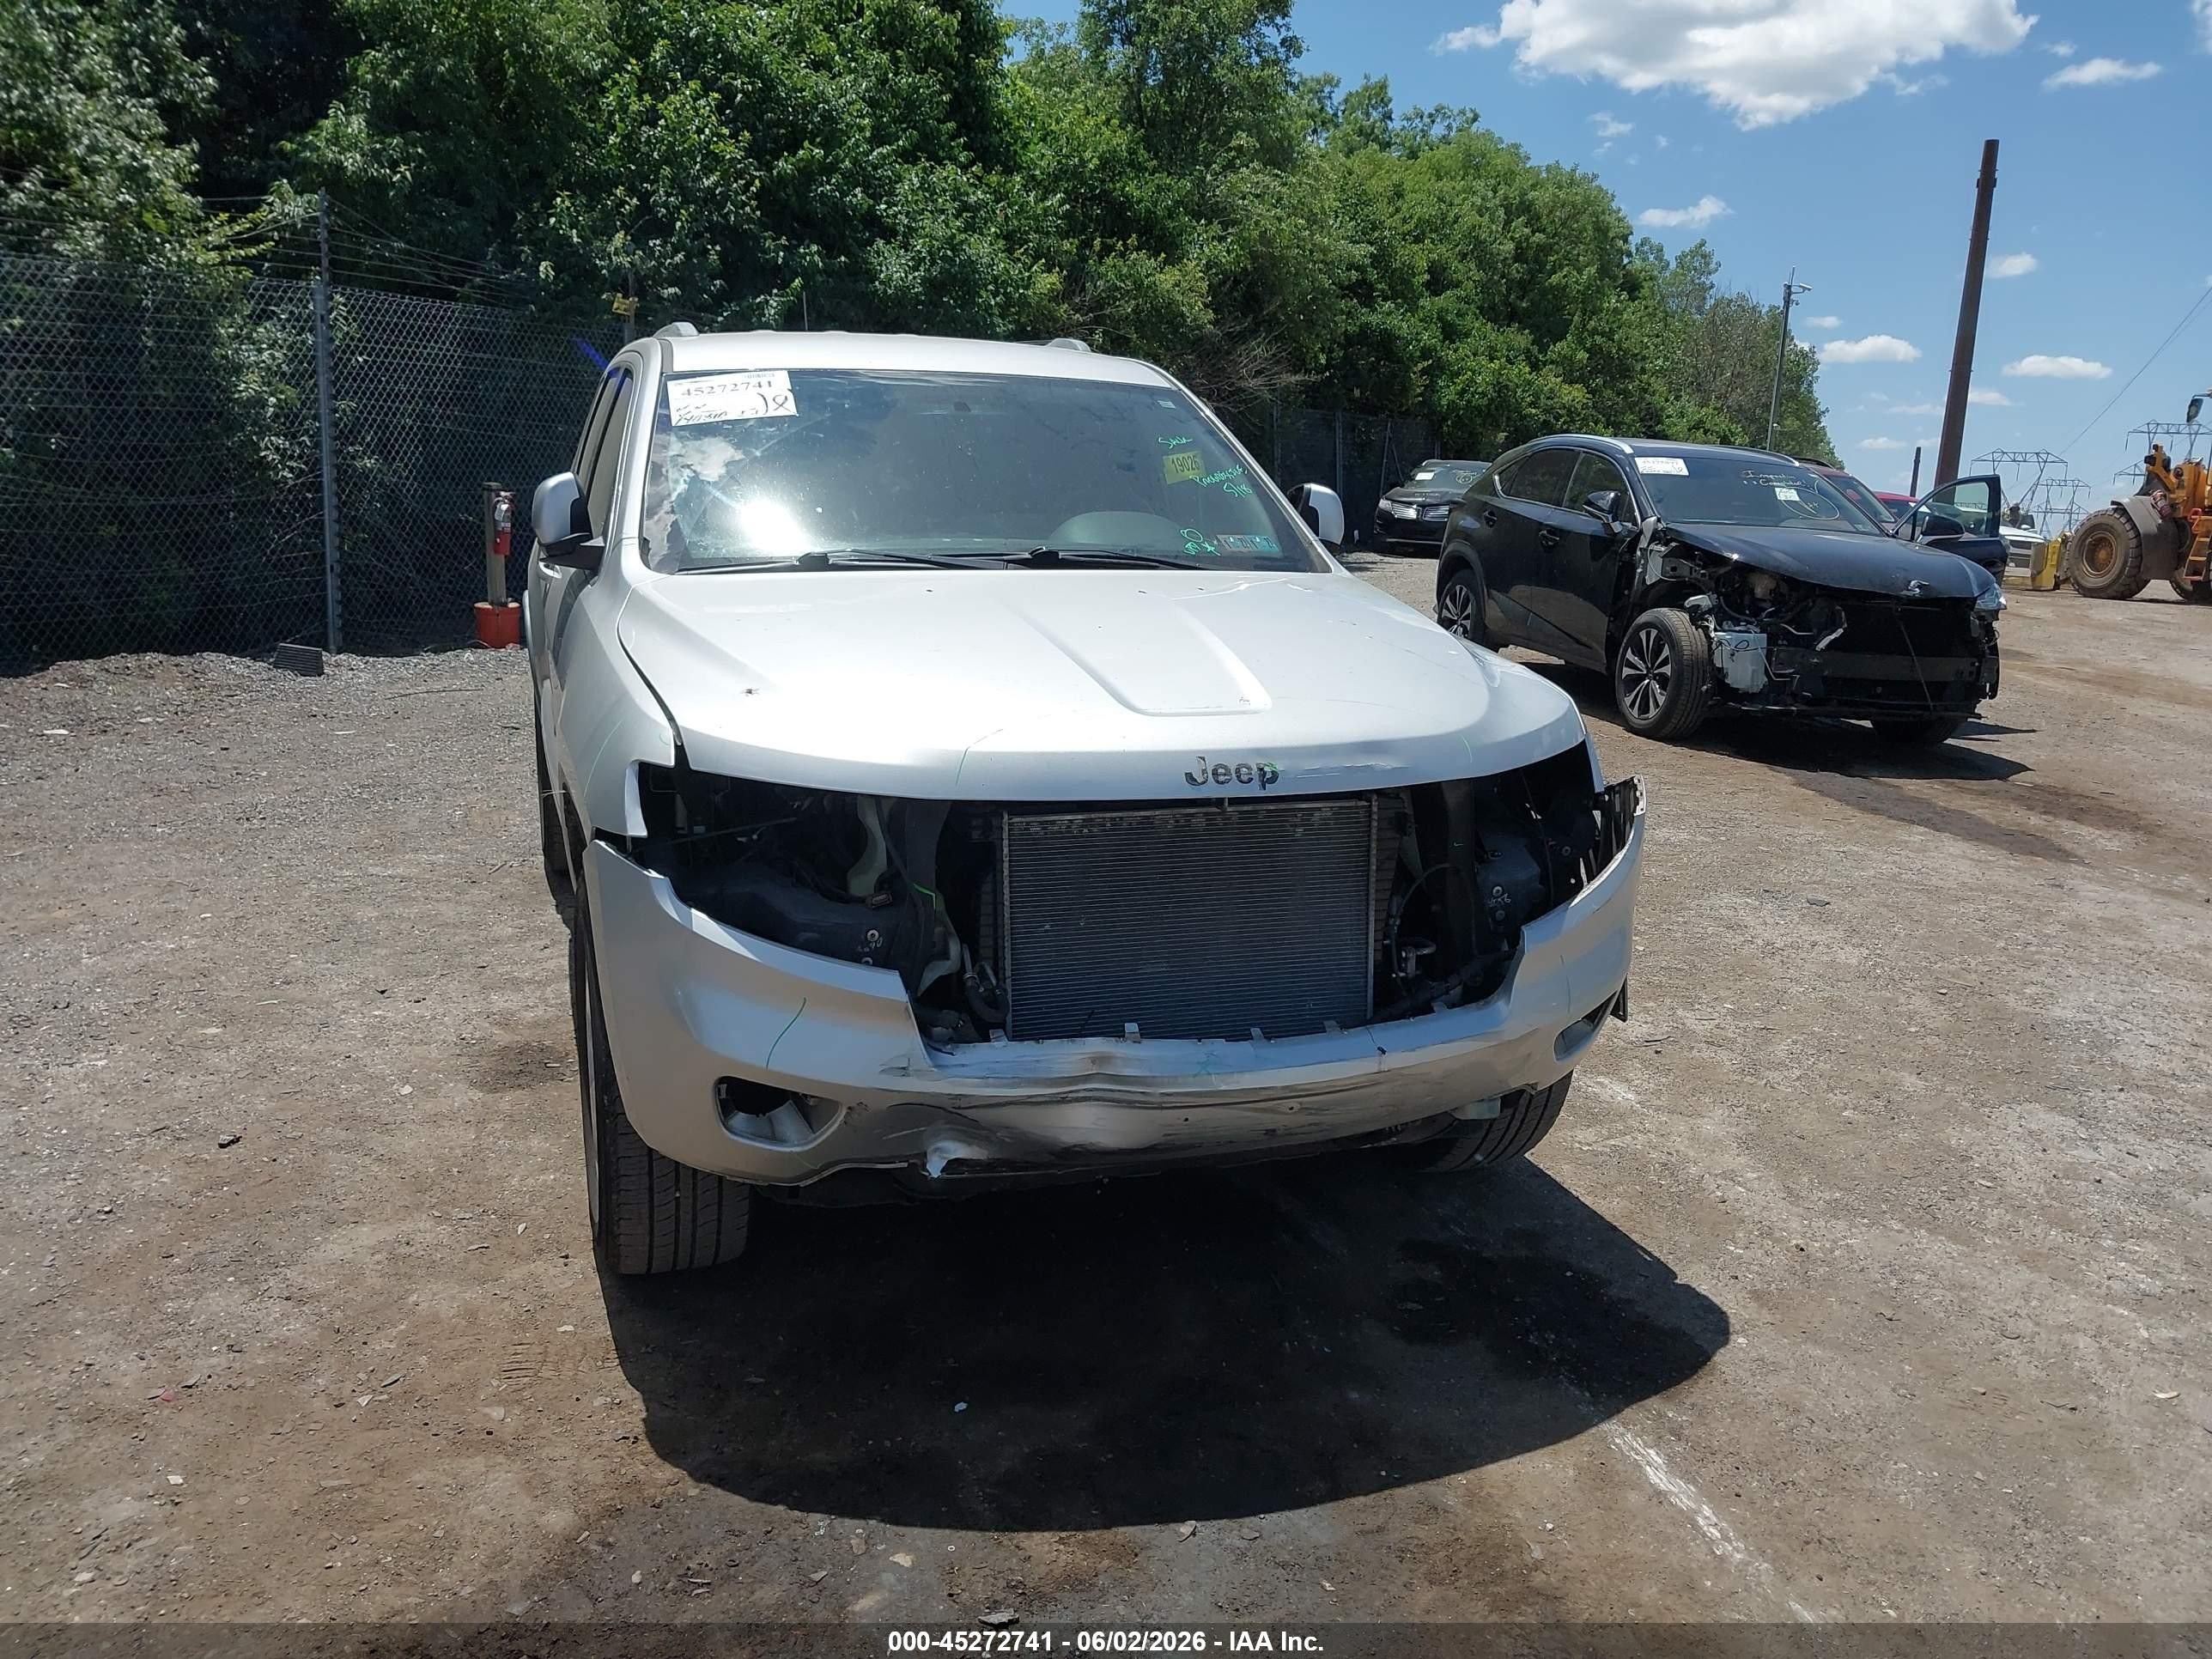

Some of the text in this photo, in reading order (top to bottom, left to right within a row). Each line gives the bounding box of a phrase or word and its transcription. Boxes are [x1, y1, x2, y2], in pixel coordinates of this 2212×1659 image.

[681, 380, 772, 397] 45272741
[1171, 454, 1200, 474] 19026
[1184, 756, 1279, 791] Jeep
